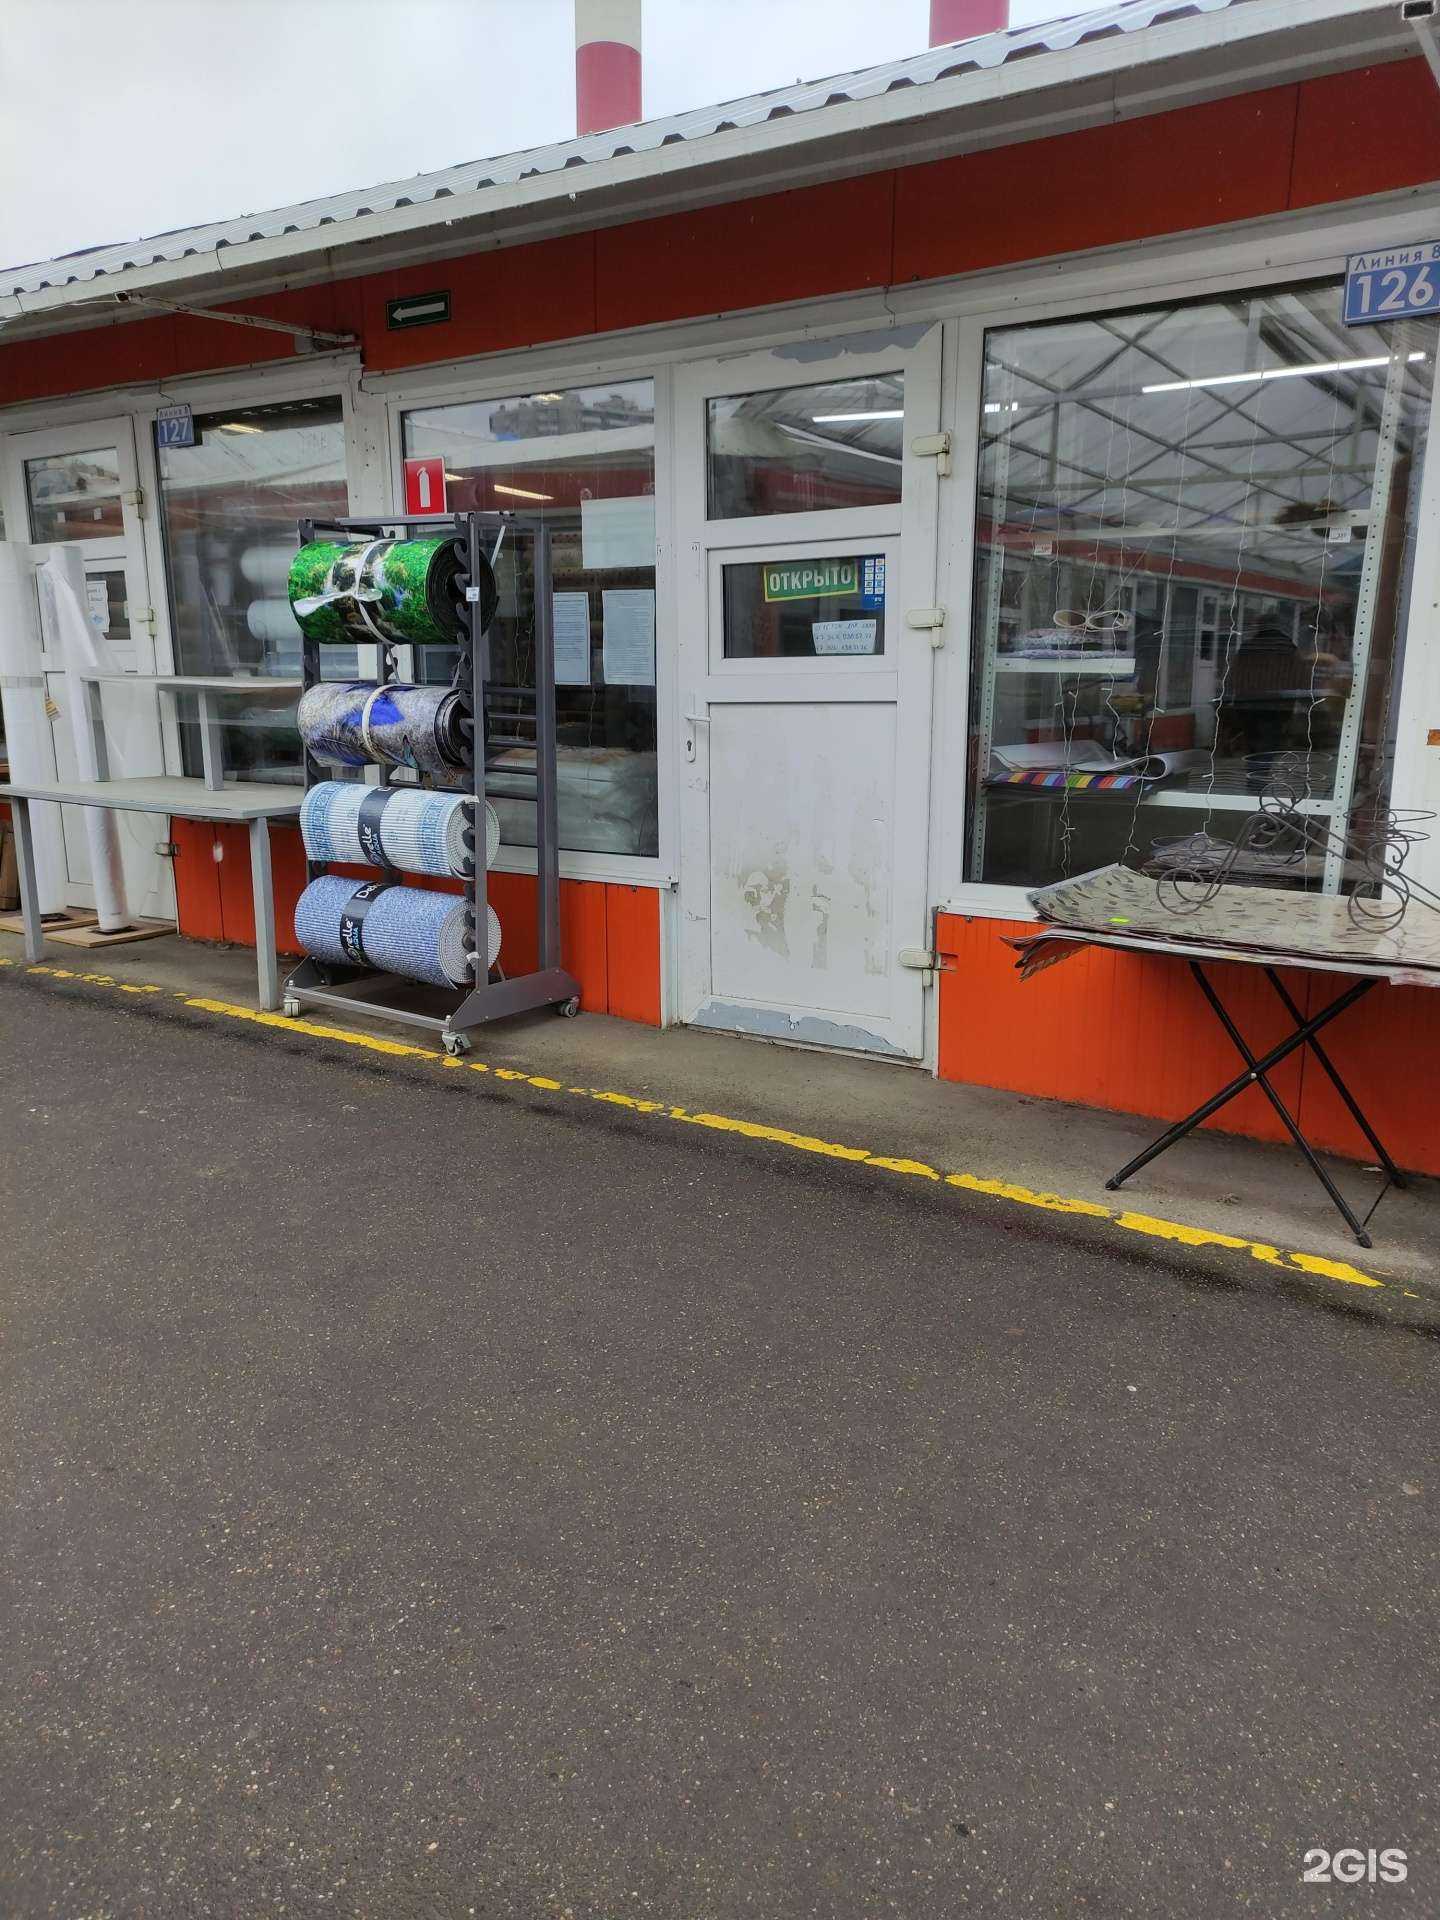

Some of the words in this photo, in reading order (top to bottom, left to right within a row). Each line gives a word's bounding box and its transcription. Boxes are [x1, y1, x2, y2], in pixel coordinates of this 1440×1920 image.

[1355, 265, 1434, 314] 126
[160, 417, 189, 443] 127
[768, 564, 852, 593] ОТКРЫТО
